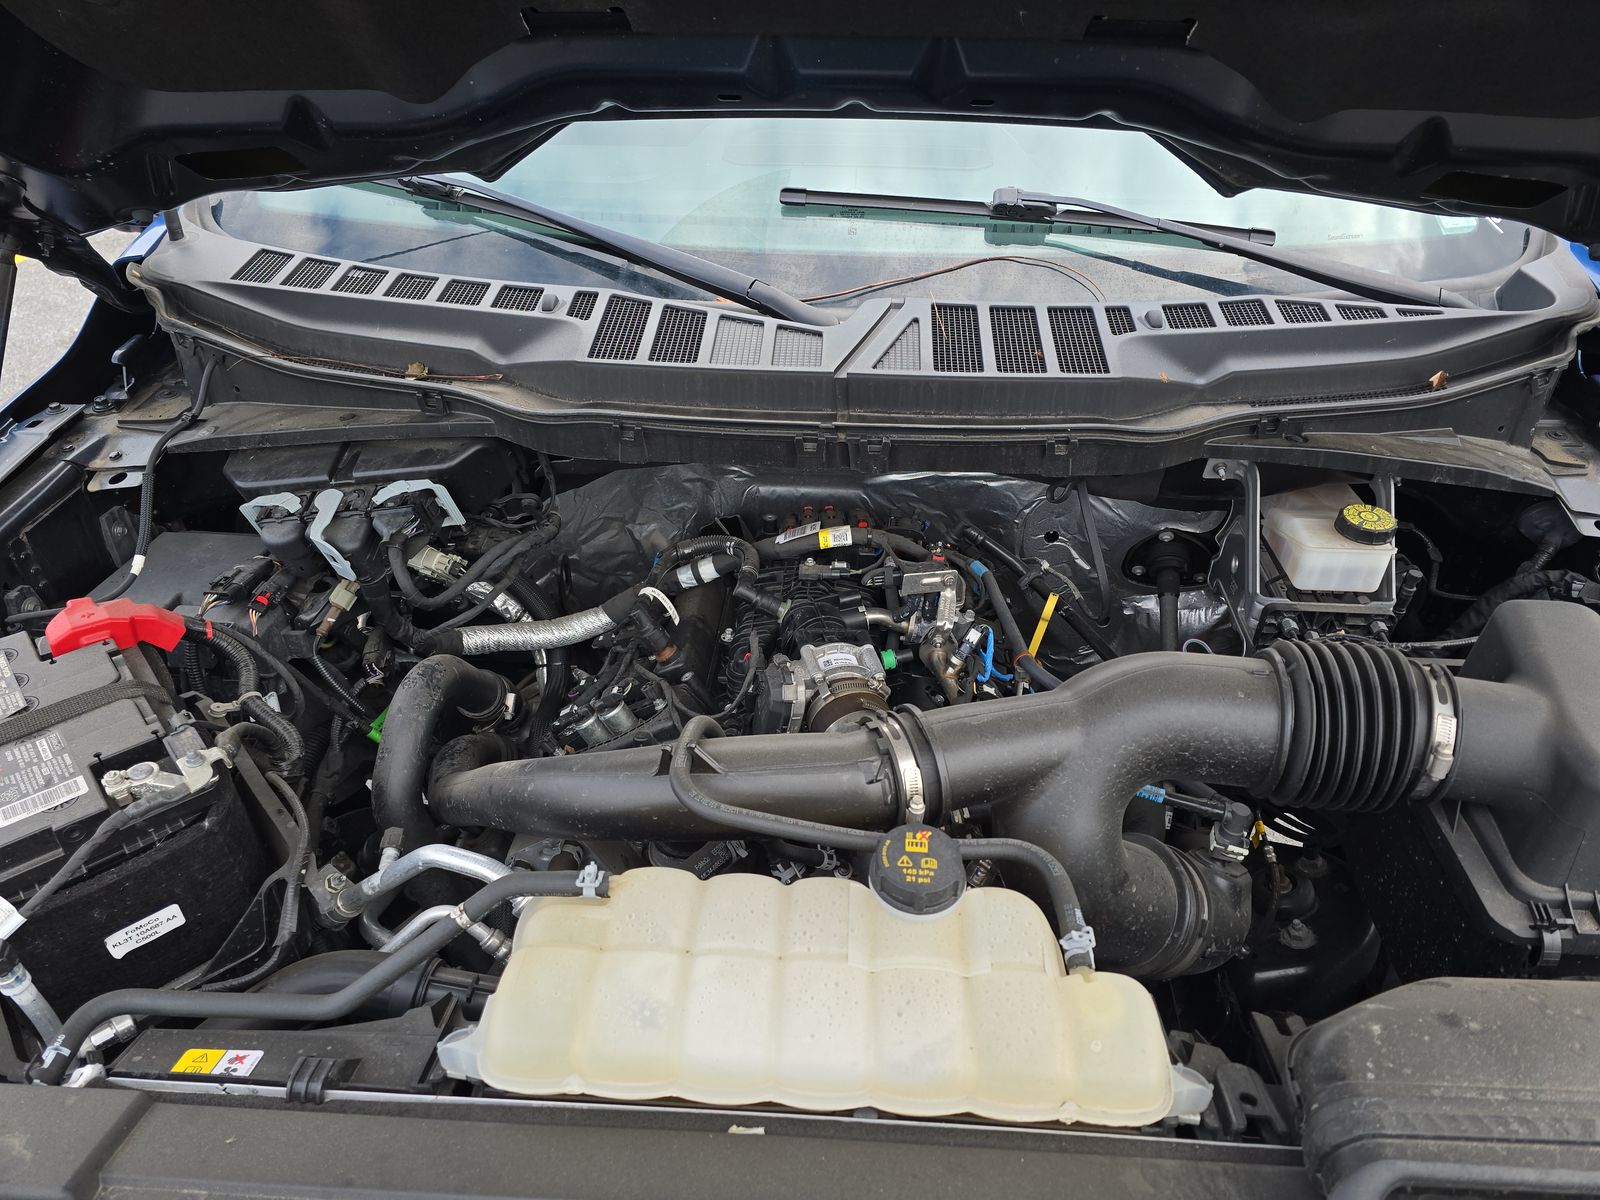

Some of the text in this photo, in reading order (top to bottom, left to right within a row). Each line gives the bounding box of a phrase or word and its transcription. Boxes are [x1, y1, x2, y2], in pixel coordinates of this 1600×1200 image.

[112, 936, 133, 949] KL3T
[166, 914, 178, 923] AA
[124, 917, 160, 936] FoMoCo
